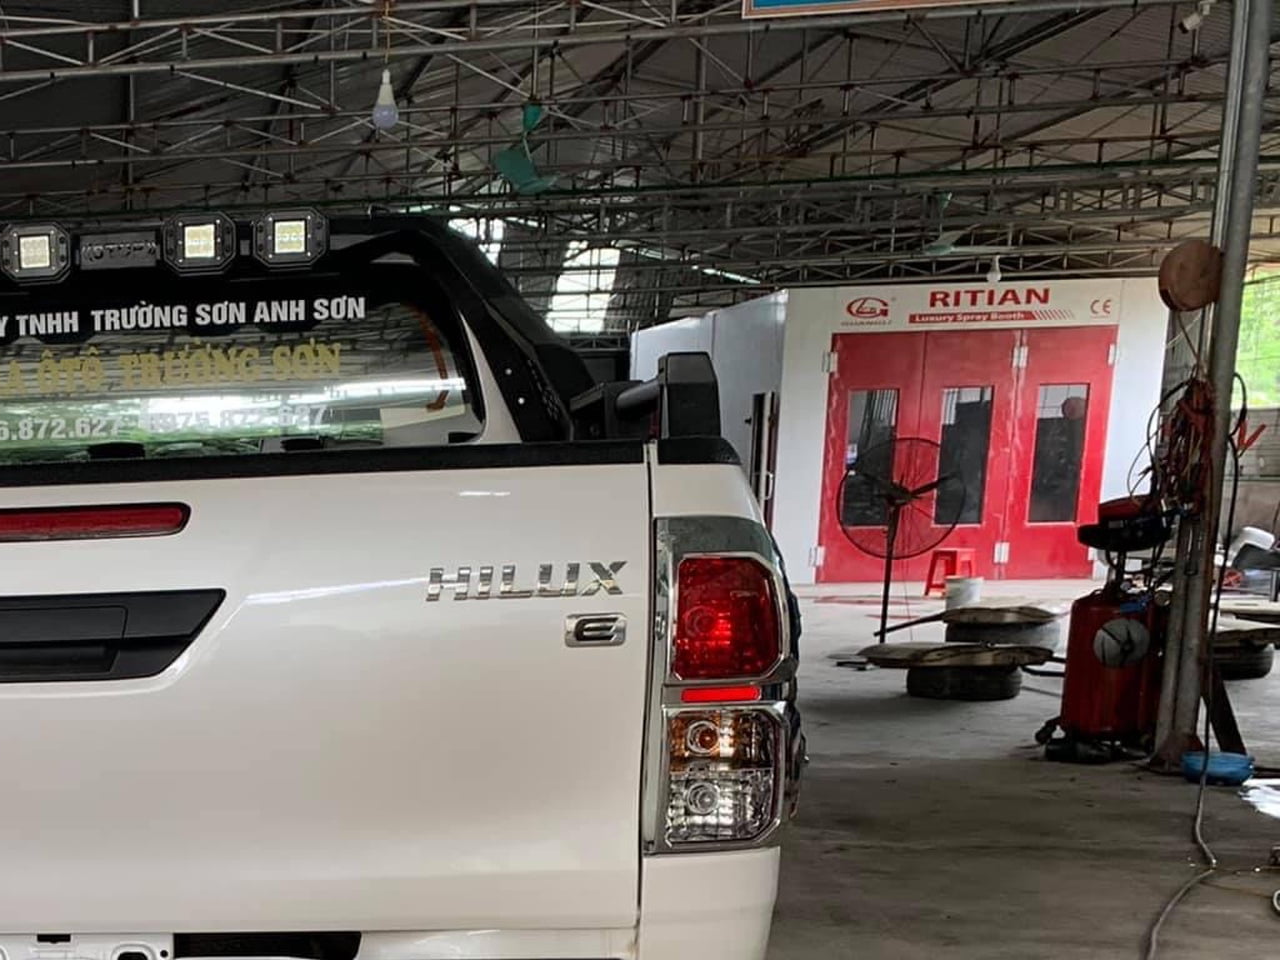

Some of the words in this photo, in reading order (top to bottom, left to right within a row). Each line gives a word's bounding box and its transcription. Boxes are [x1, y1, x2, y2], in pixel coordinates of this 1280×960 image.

[929, 287, 1050, 308] RITIAN
[14, 311, 79, 337] TNHH
[91, 300, 188, 333] TRƯỜNG
[194, 301, 249, 326] SƠN
[254, 300, 305, 322] ANH
[312, 296, 367, 320] SƠN
[914, 313, 955, 324] Luxury
[956, 312, 989, 323] Spray
[991, 311, 1025, 321] Booth
[425, 561, 628, 602] HILUX
